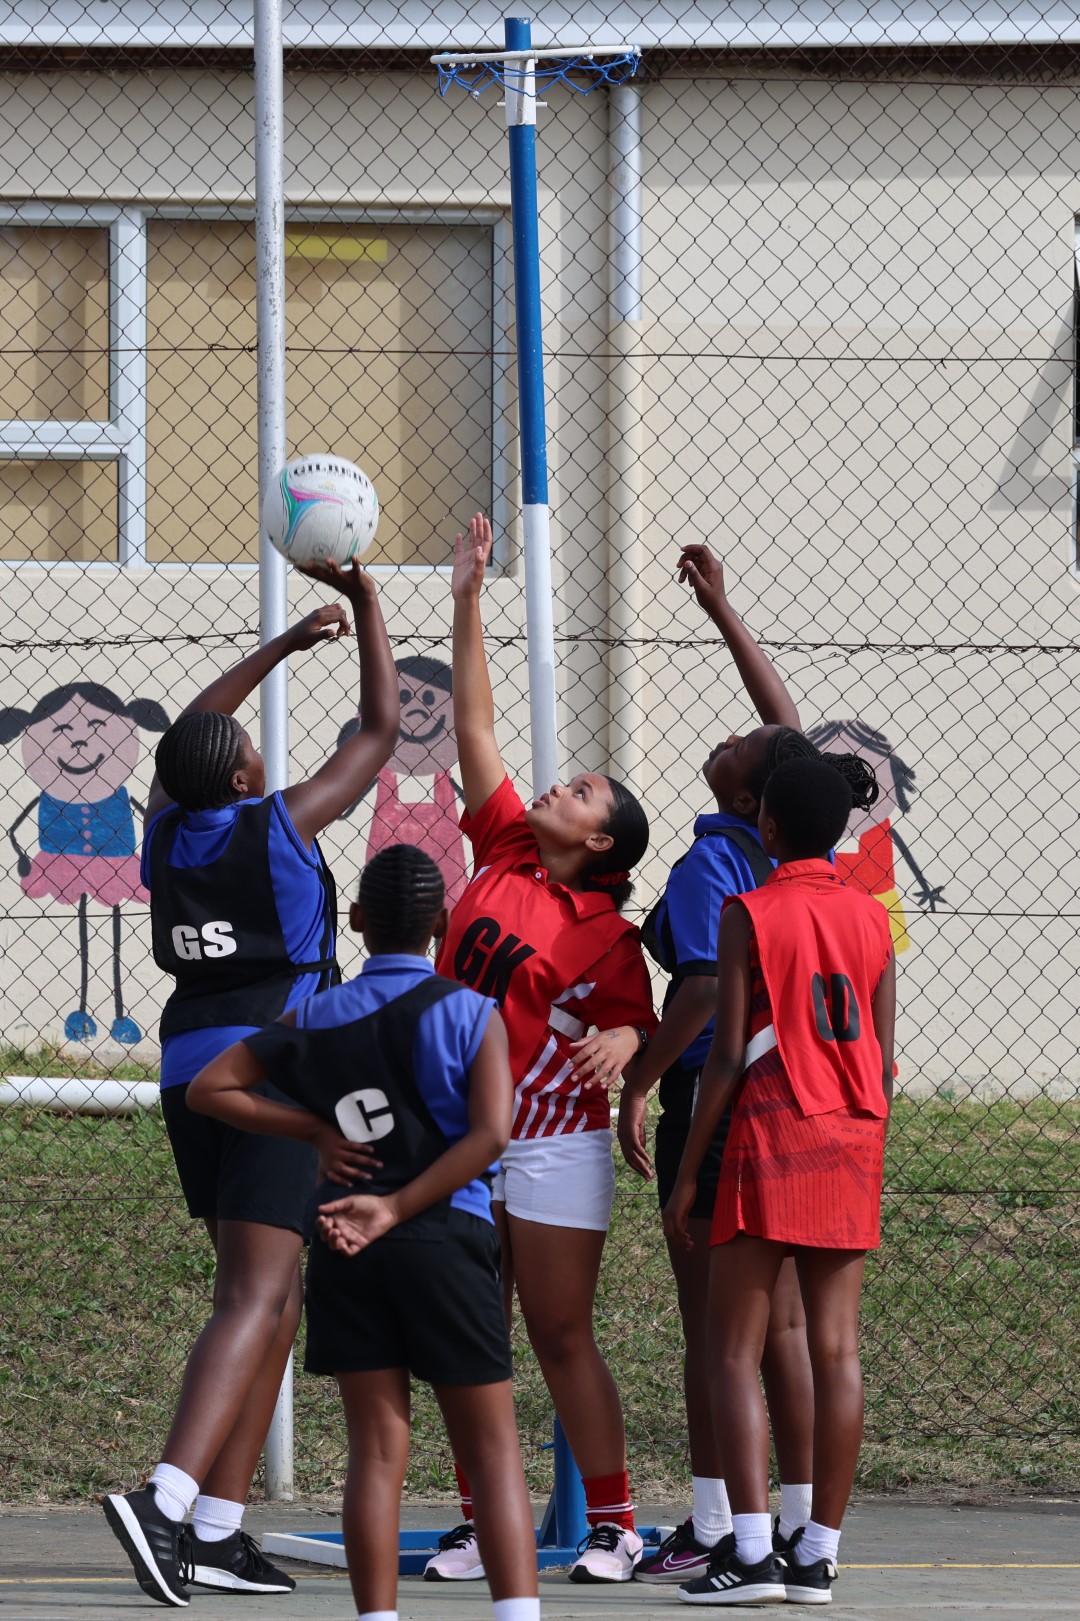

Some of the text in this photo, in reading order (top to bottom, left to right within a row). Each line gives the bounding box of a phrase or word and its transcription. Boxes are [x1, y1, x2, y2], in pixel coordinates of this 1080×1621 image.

[171, 920, 237, 960] GS
[454, 916, 537, 1008] GK
[334, 1087, 395, 1144] C
